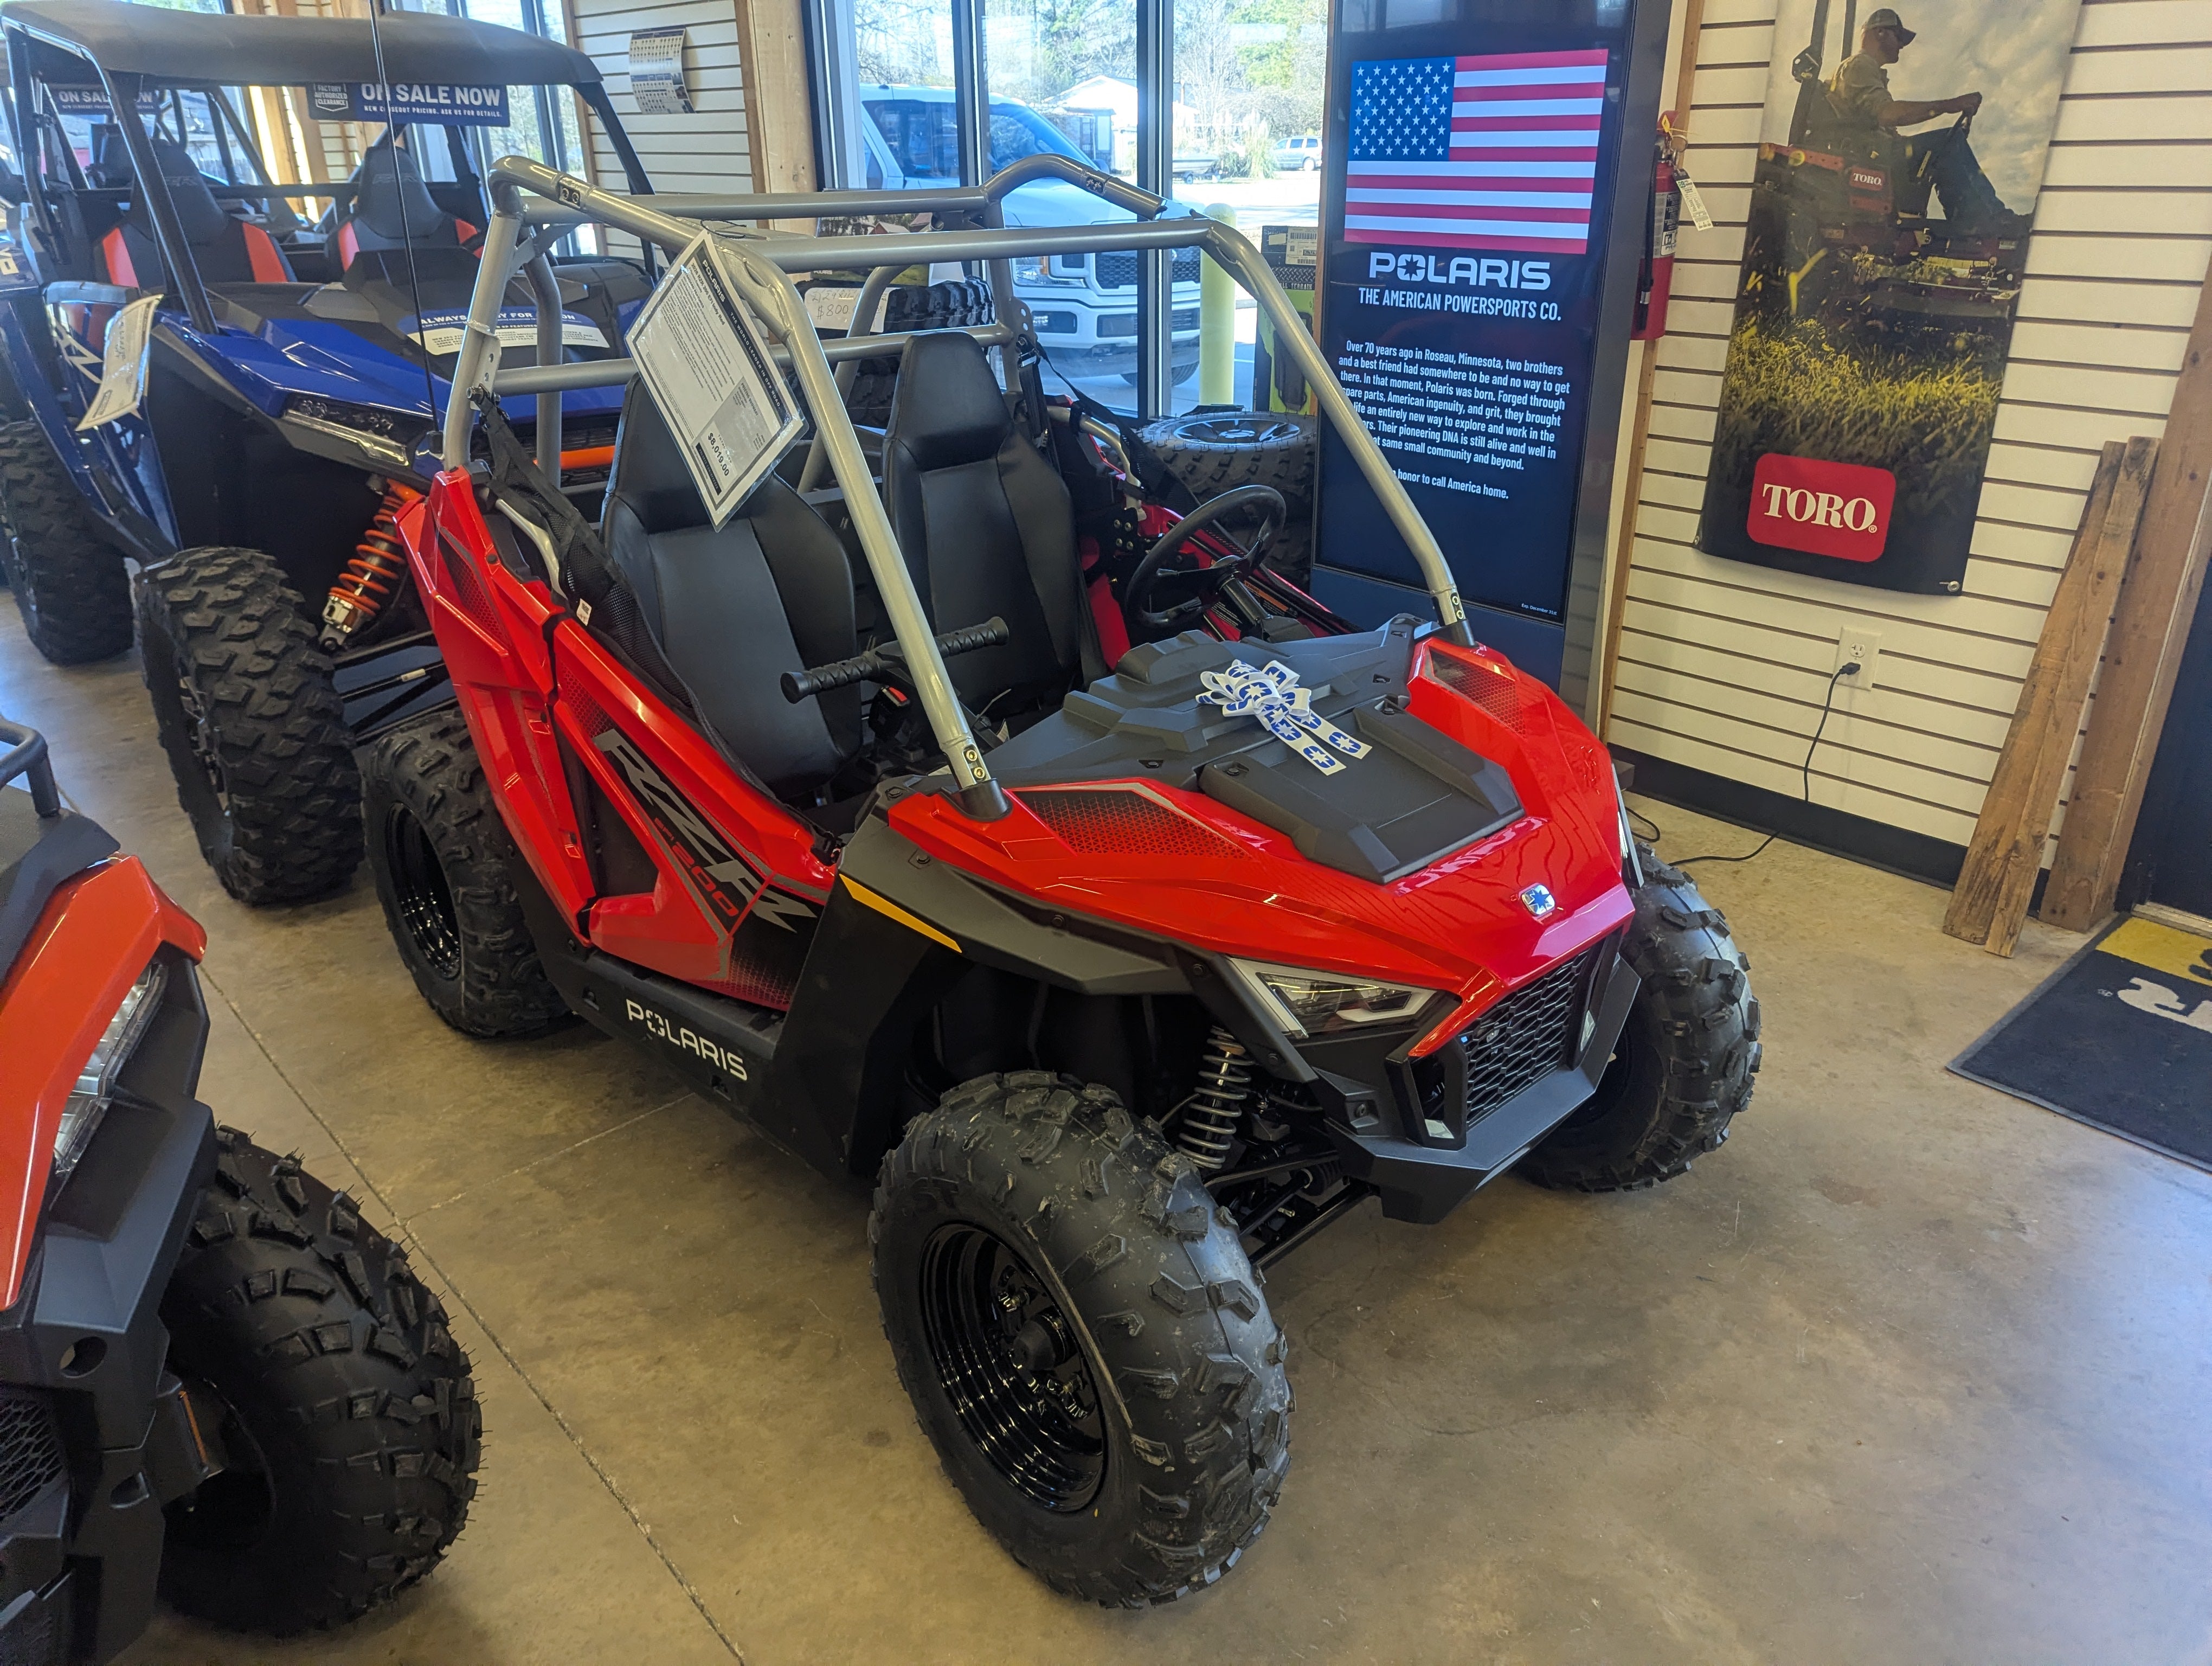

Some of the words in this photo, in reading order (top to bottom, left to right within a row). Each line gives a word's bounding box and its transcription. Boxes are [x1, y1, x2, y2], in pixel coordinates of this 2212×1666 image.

[58, 91, 80, 102] ON
[82, 91, 110, 102] SAL
[361, 84, 390, 101] ON
[395, 84, 451, 104] SALE
[455, 87, 500, 106] NOW
[703, 259, 725, 302] POLARIS
[1369, 252, 1551, 291] POLARIS
[421, 315, 467, 324] ALWAYS
[1359, 287, 1380, 305] THE
[1382, 289, 1442, 310] AMERICAN
[1444, 294, 1537, 319] POWERSPORTS
[1540, 302, 1561, 321] CO.
[1339, 355, 1353, 367] and
[1354, 358, 1359, 368] a
[1360, 357, 1378, 370] best
[1379, 359, 1402, 373] friend
[1403, 362, 1418, 375] had
[1419, 367, 1467, 381] somewhere
[1469, 370, 1477, 382] to
[1479, 371, 1490, 384] be
[1491, 374, 1509, 386] and
[1510, 377, 1521, 388] no
[1523, 379, 1541, 393] way
[1543, 380, 1553, 392] to
[1554, 382, 1570, 395] get
[1346, 340, 1364, 353] Over
[1365, 342, 1374, 354] 70
[1375, 345, 1397, 357] years
[1398, 348, 1413, 361] ago
[1414, 347, 1423, 360] in
[1424, 349, 1456, 365] Roseau,
[1458, 352, 1503, 370] Minnesota,
[1506, 358, 1522, 371] two
[1523, 360, 1563, 376] brothers
[1340, 370, 1362, 383] there.
[1364, 373, 1371, 384] In
[1372, 374, 1388, 387] that
[1390, 379, 1424, 393] moment,
[1425, 380, 1454, 395] Polaris
[1455, 387, 1472, 398] was
[1474, 387, 1496, 401] born.
[1497, 390, 1528, 407] Forged
[1529, 394, 1565, 412] through
[1364, 390, 1386, 403] parts,
[1387, 391, 1424, 407] American
[1426, 396, 1465, 415] ingenuity,
[1467, 403, 1484, 415] and
[1485, 405, 1502, 420] grit,
[1504, 407, 1524, 424] they
[1525, 410, 1561, 428] brought
[1367, 406, 1377, 415] an
[1378, 406, 1407, 422] entirely
[1409, 412, 1425, 422] new
[1426, 414, 1443, 428] way
[1444, 415, 1453, 427] to
[1455, 418, 1486, 432] explore
[1487, 423, 1504, 435] and
[1506, 426, 1528, 438] work
[1529, 427, 1538, 440] in
[1540, 429, 1555, 443] the
[1378, 420, 1398, 433] Their
[1399, 424, 1441, 443] pioneering
[1442, 430, 1459, 444] DNA
[1460, 432, 1468, 445] is
[1469, 435, 1486, 448] still
[1487, 438, 1508, 451] alive
[1509, 443, 1526, 454] and
[1528, 445, 1546, 457] well
[1547, 446, 1556, 459] in
[708, 432, 730, 476] $8,019.00
[1381, 438, 1403, 450] same
[1404, 442, 1425, 453] small
[1426, 446, 1472, 464] community
[1473, 453, 1489, 464] and
[1490, 453, 1524, 470] beyond.
[1398, 468, 1420, 483] honor
[1422, 473, 1430, 484] to
[1431, 476, 1446, 488] call
[1447, 477, 1481, 494] America
[1483, 484, 1509, 499] home.
[1529, 605, 1548, 613] December
[593, 729, 818, 934] RZR
[672, 841, 739, 917] 200
[626, 999, 748, 1082] POLARIS
